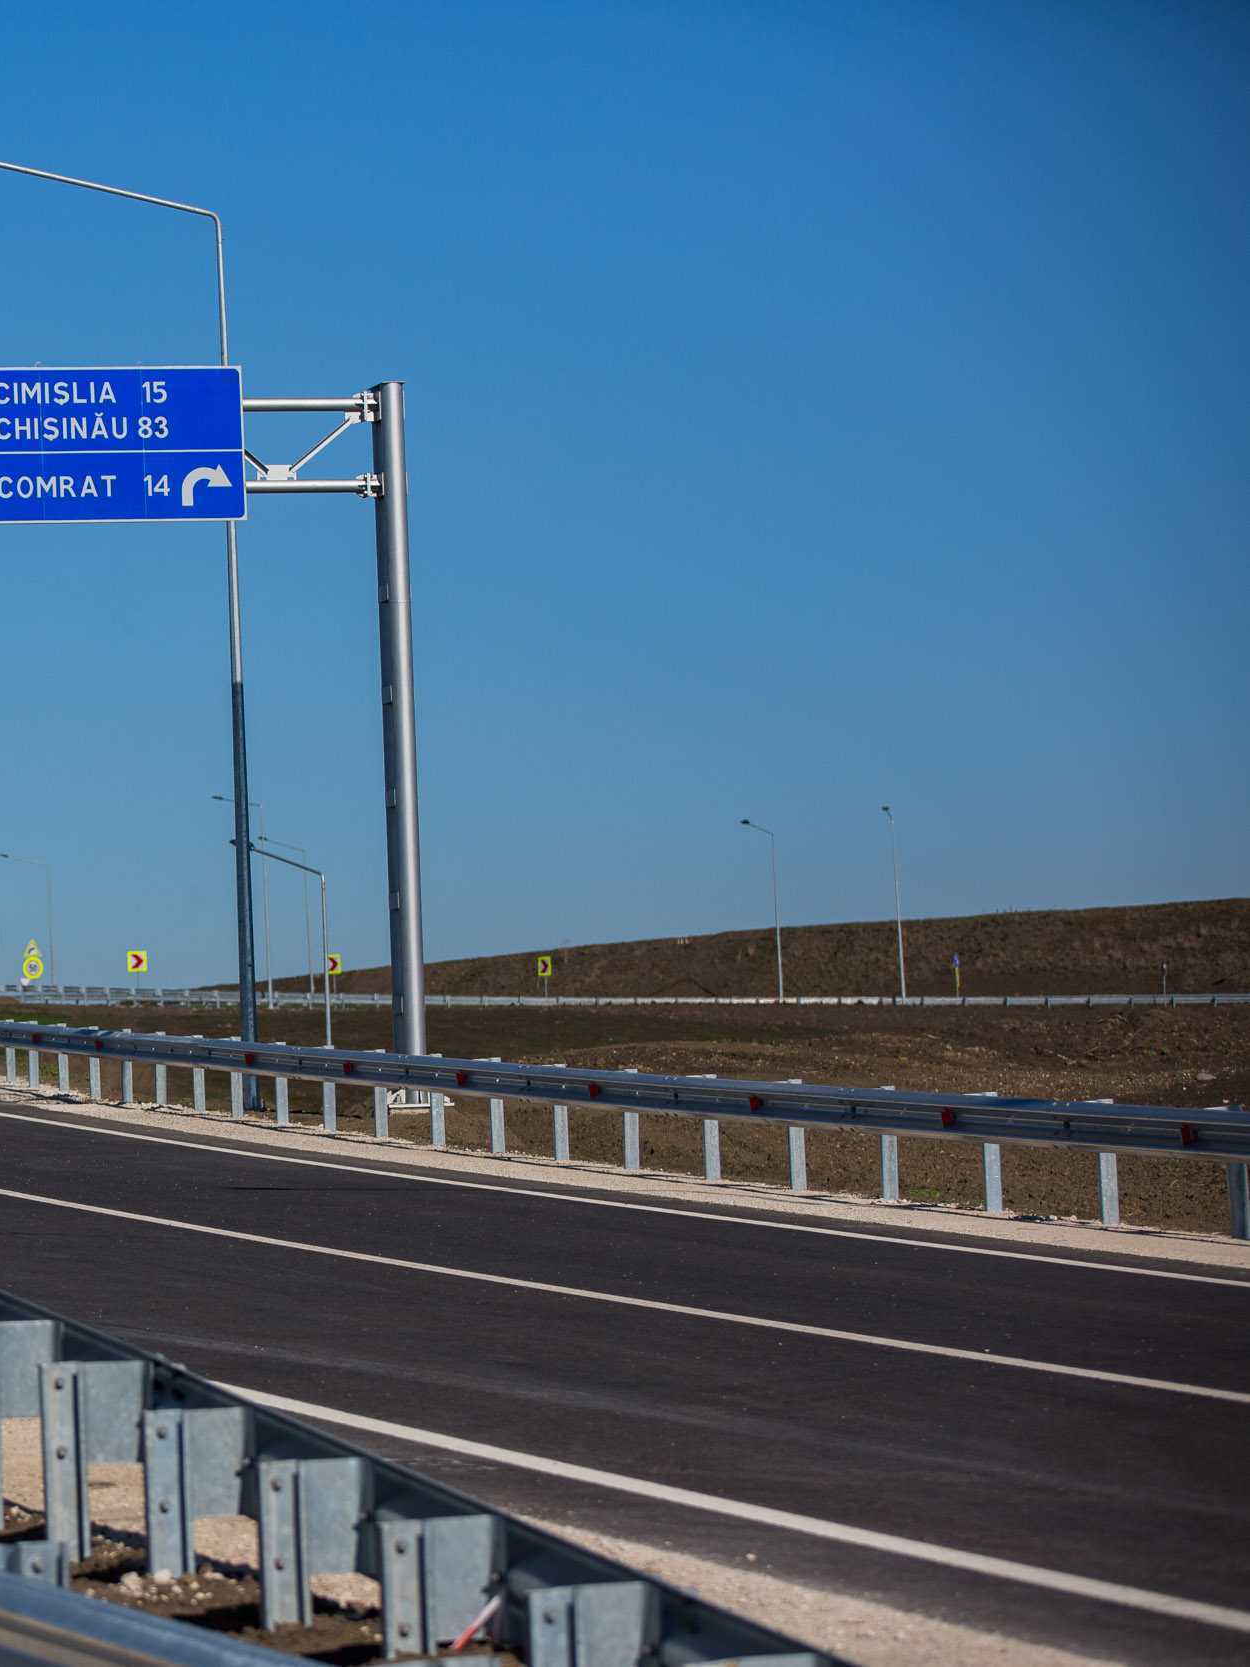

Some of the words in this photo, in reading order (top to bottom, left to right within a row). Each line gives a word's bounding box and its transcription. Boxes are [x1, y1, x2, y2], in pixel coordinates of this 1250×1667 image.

[141, 381, 168, 404] 15
[137, 416, 169, 439] 83
[143, 474, 171, 497] 14
